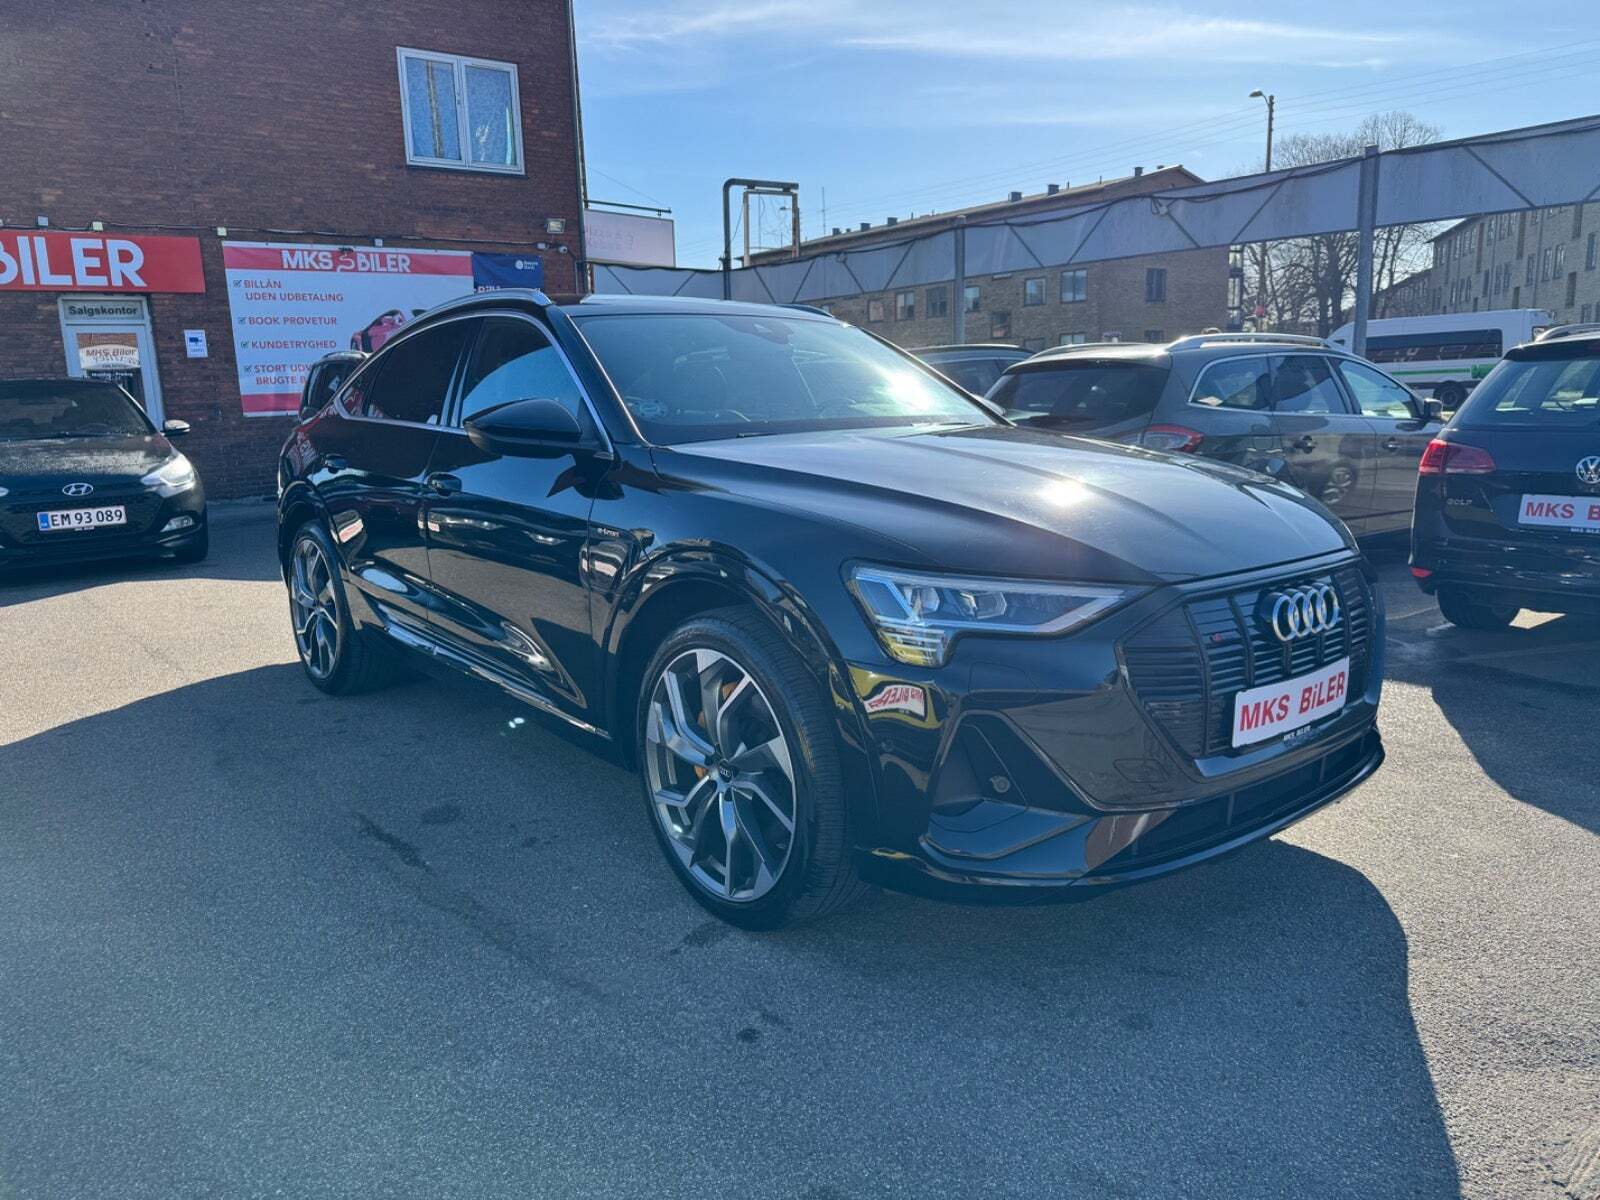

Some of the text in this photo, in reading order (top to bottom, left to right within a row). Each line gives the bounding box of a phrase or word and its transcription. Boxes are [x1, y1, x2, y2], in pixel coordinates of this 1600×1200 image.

[281, 250, 411, 273] MKS BILER
[244, 278, 282, 289] BILLÅN
[245, 292, 344, 302] UDEN UDBETALING
[68, 305, 138, 317] Salgskontor
[248, 316, 337, 325] BOOK PRØVETUR
[251, 340, 337, 349] KUNDETRYGHED
[254, 364, 287, 373] STORT
[256, 377, 297, 385] BRUGTE
[1525, 502, 1575, 519] MKS
[51, 509, 123, 527] EM 93 089
[1239, 694, 1291, 732] MKS
